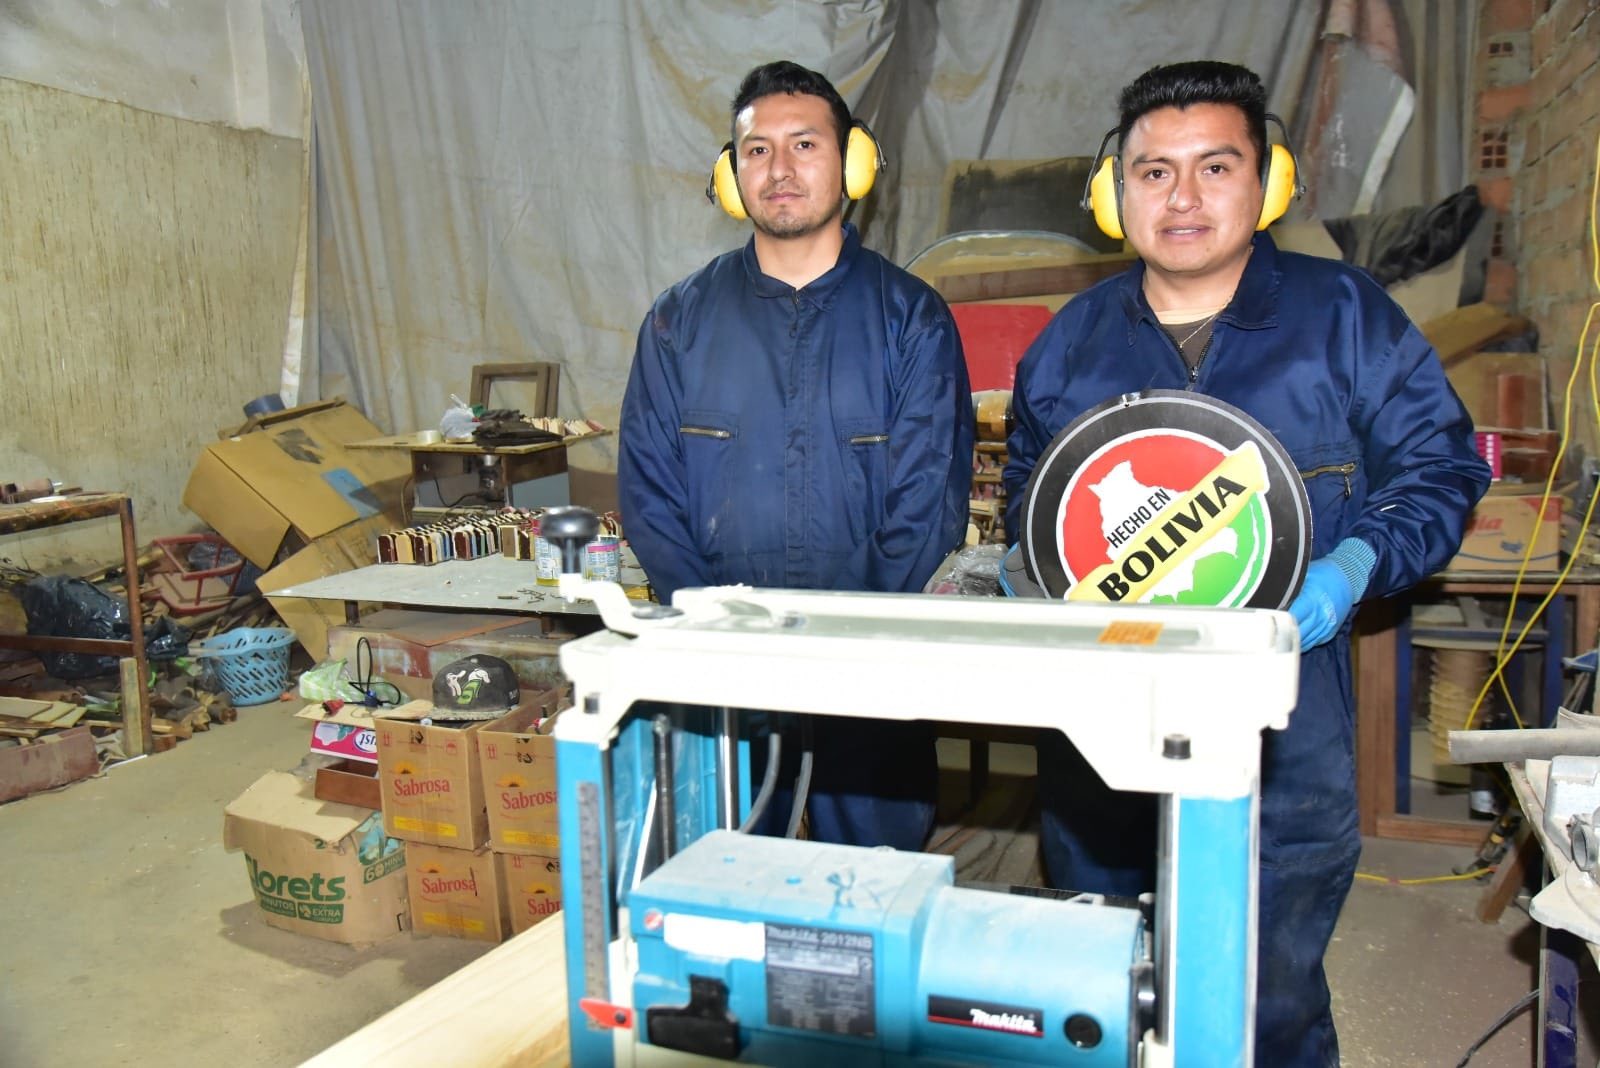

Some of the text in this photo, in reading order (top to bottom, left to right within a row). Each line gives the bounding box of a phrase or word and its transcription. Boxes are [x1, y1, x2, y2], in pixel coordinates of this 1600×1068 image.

[1106, 487, 1172, 549] HECHO EN
[1097, 475, 1248, 601] BOLIVIA
[394, 778, 450, 798] Sabrosa
[421, 877, 477, 894] Sabrosa
[312, 908, 341, 918] EXTRA
[527, 897, 561, 916] Sabr
[969, 1008, 1037, 1033] Makita
